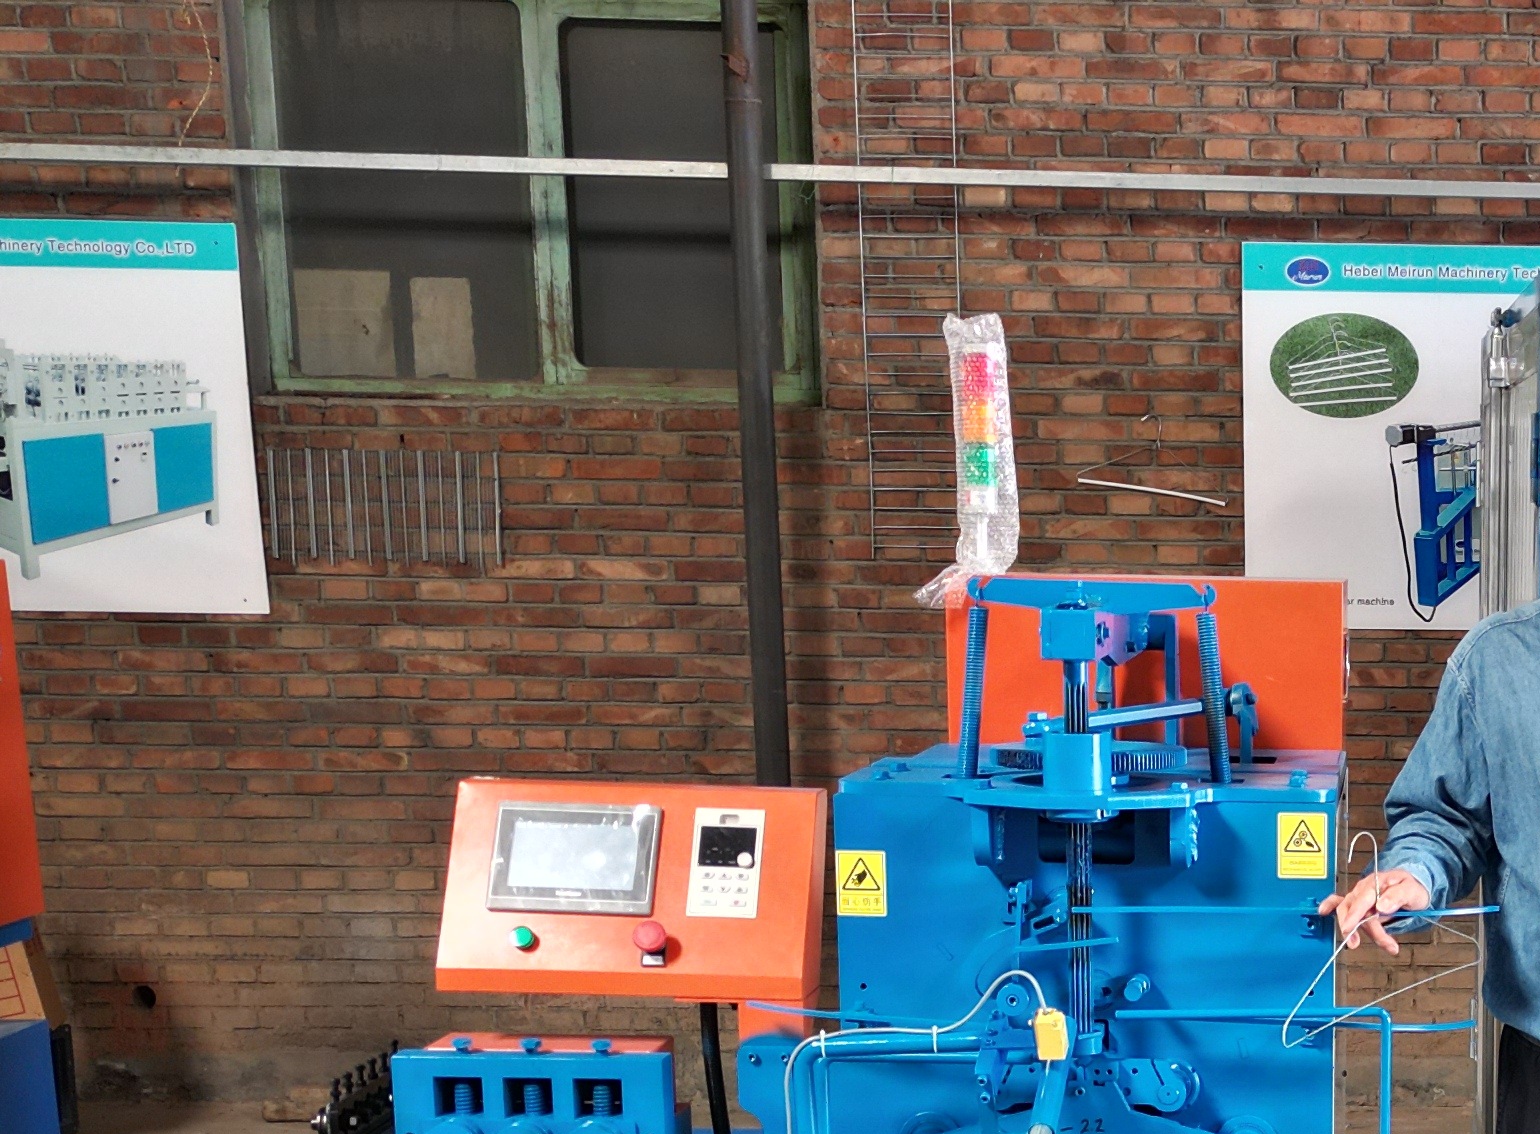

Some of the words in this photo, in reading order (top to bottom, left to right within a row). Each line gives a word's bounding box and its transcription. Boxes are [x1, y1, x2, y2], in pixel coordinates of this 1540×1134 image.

[47, 239, 131, 256] Technology
[1343, 264, 1383, 277] Hebei
[1388, 265, 1433, 278] Meirun
[1438, 265, 1507, 281] Machinery
